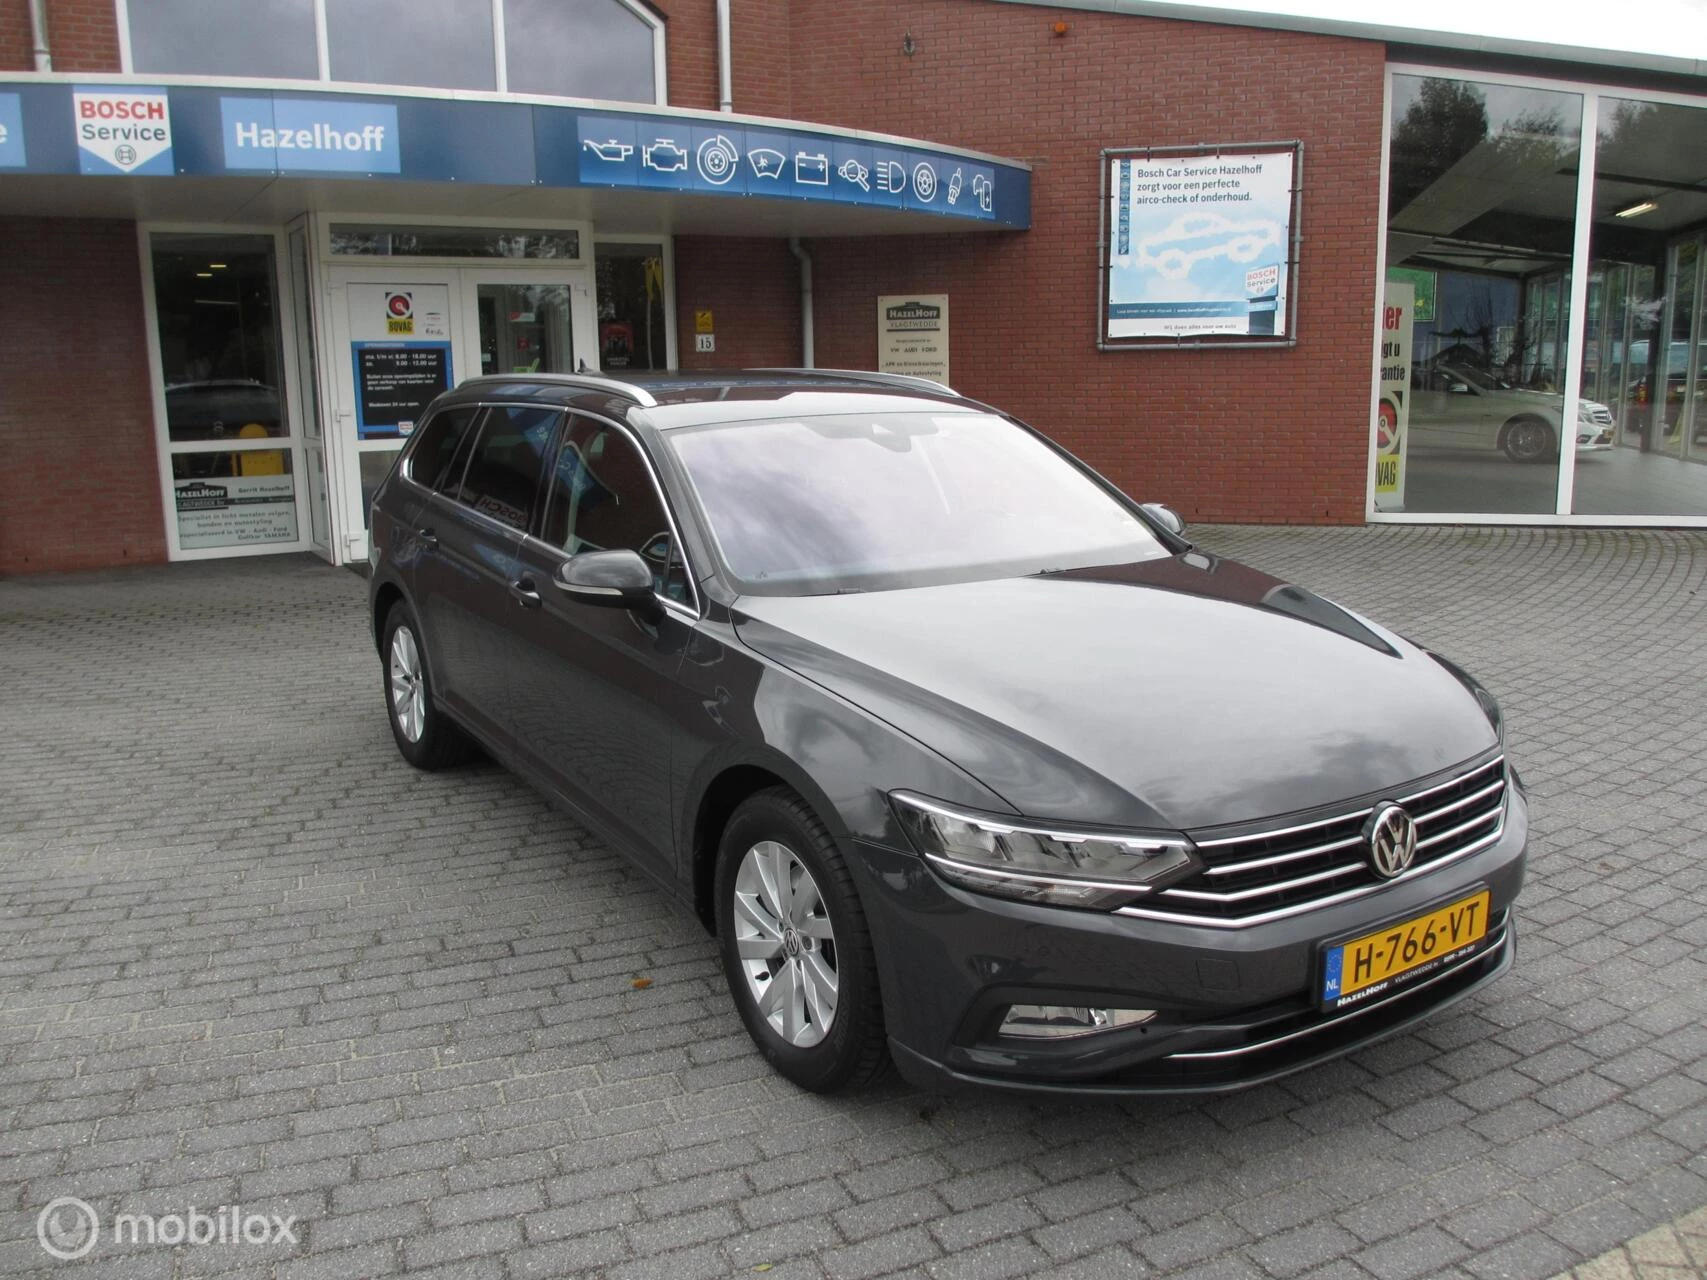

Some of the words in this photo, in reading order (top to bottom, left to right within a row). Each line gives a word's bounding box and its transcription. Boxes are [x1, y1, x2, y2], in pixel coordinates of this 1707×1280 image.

[80, 100, 165, 120] BOSCH
[82, 123, 166, 142] Service
[236, 122, 385, 152] Hazelhoff
[1137, 168, 1165, 178] Bosch
[1166, 168, 1183, 178] Car
[1184, 166, 1218, 177] Service
[1219, 164, 1263, 176] Hazelhoff
[1136, 183, 1160, 192] zorgt
[1162, 182, 1182, 190] voor
[1184, 181, 1200, 190] een
[1202, 178, 1240, 191] perfecte
[1136, 195, 1188, 205] airco-check
[1189, 194, 1200, 203] of
[1202, 192, 1252, 202] onderhoud.
[1247, 268, 1276, 280] BOSCH
[1247, 276, 1276, 288] Service
[388, 321, 412, 332] BOVAG
[698, 328, 707, 339] 15
[1394, 344, 1400, 357] u
[1354, 901, 1480, 984] H-766-VT
[1326, 979, 1338, 992] NL
